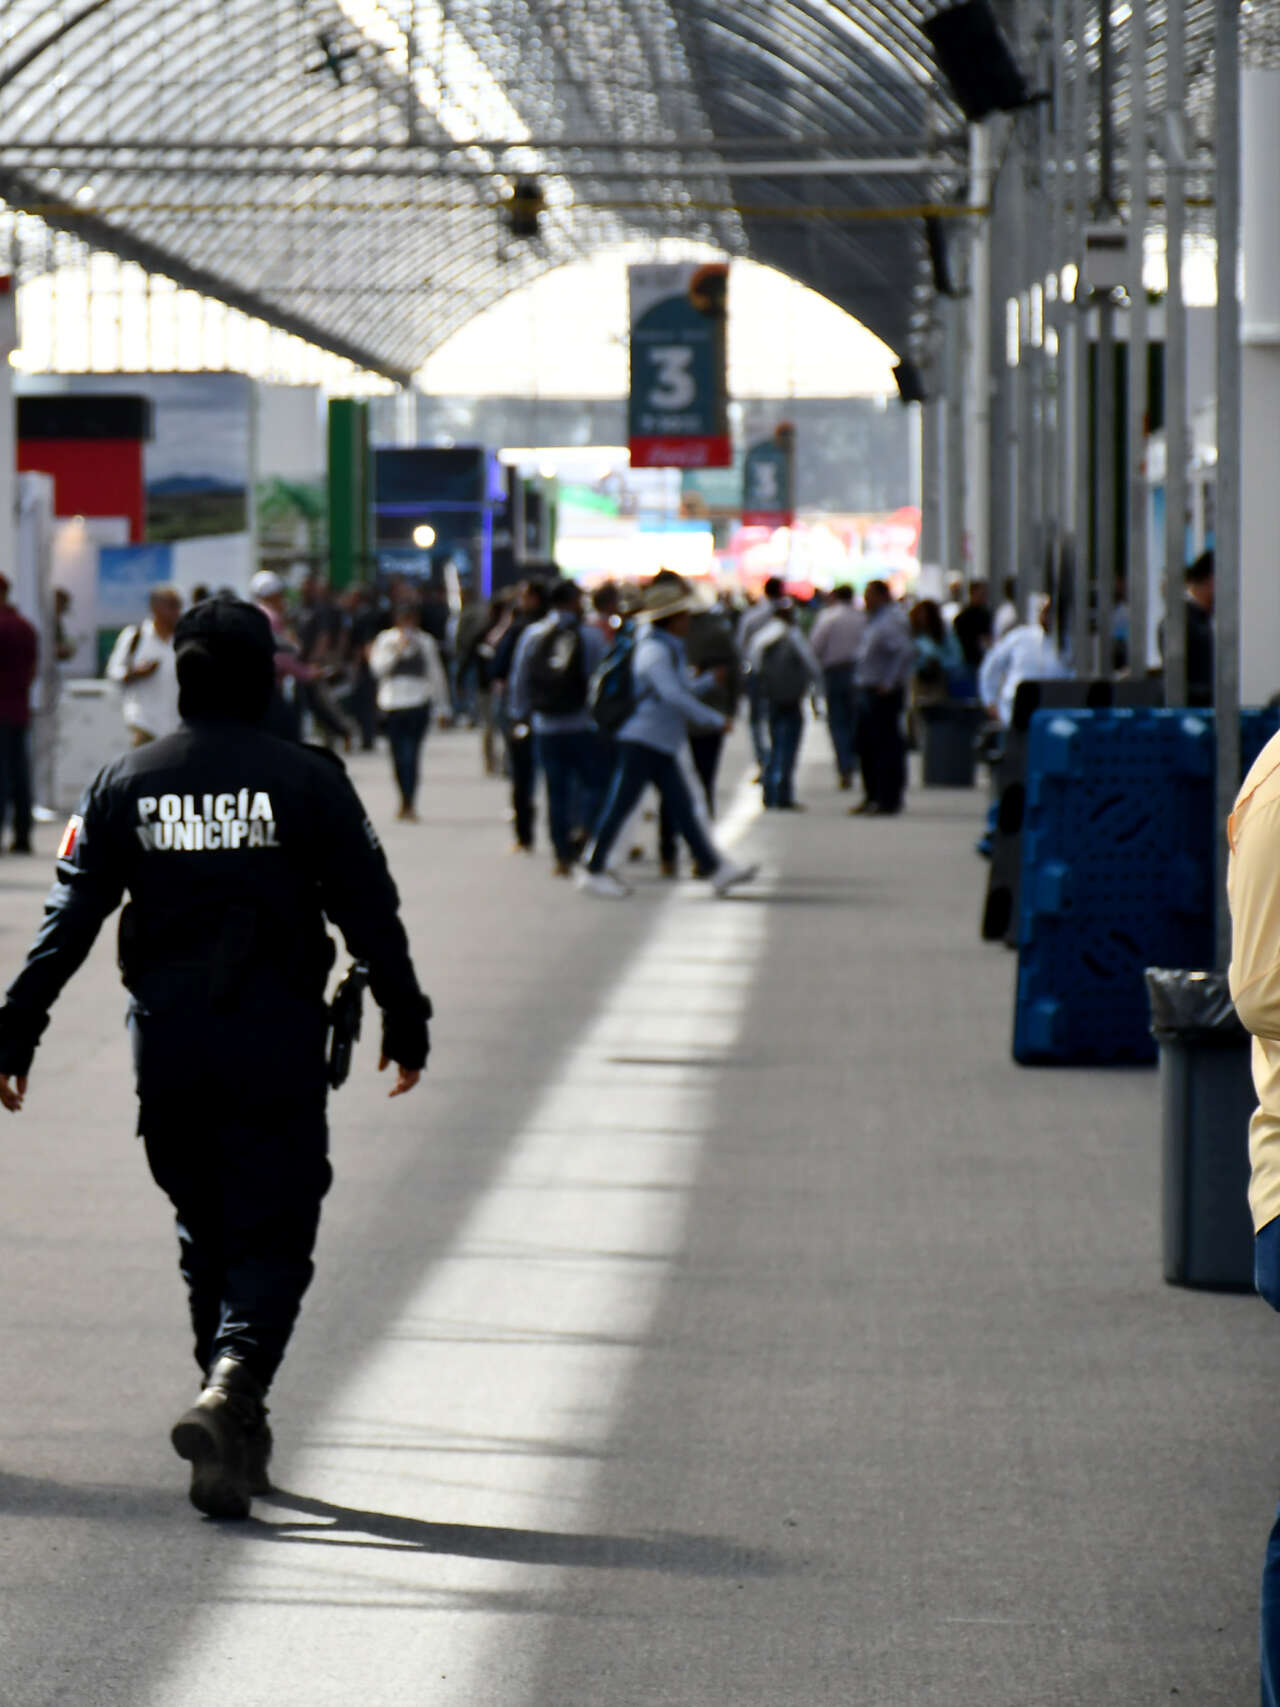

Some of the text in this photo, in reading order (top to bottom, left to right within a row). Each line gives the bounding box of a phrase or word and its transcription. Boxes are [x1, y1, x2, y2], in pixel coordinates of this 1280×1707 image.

[648, 345, 696, 409] 3
[754, 462, 777, 496] 3
[137, 787, 274, 824] POLICÍA
